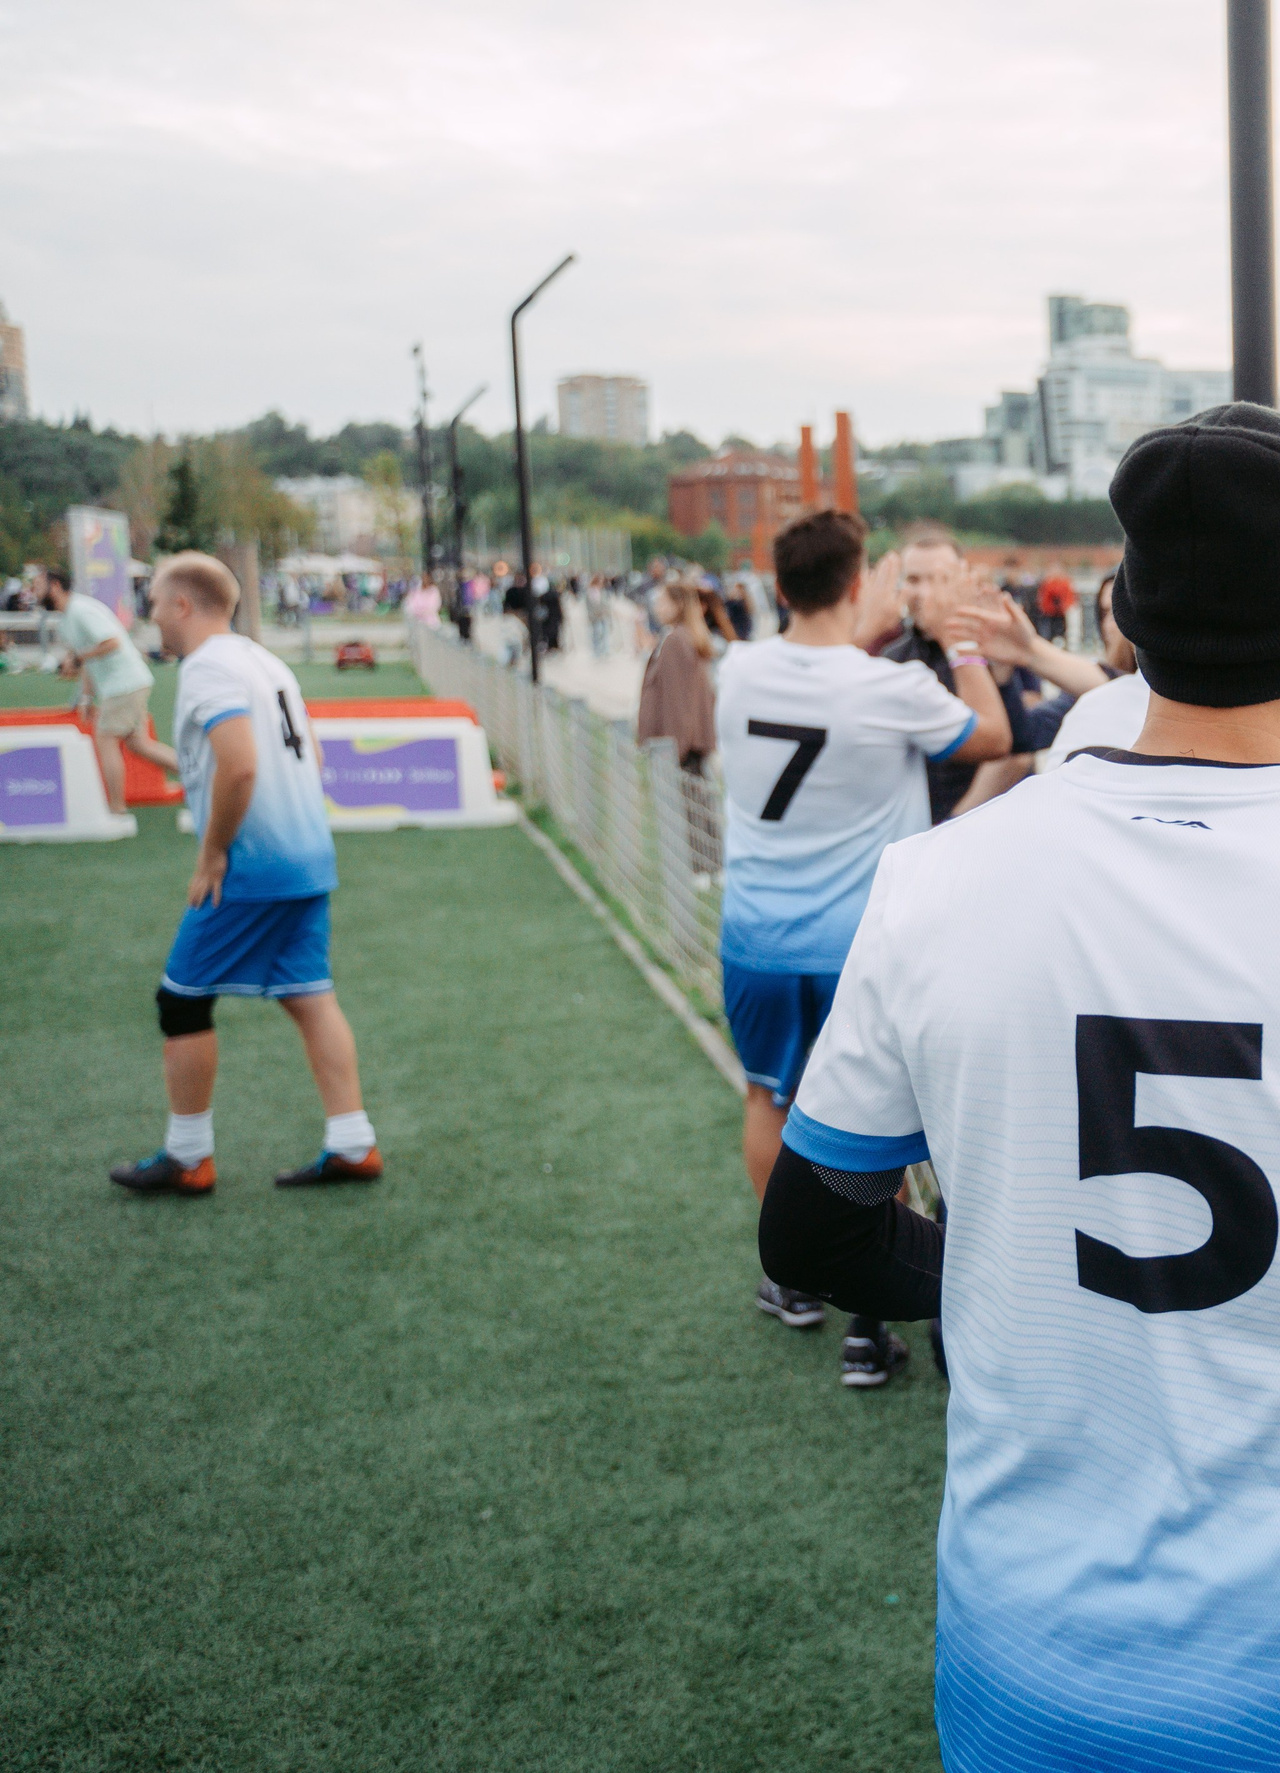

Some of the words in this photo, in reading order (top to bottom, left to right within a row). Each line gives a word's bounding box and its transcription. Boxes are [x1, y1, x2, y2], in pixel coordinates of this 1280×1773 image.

[277, 689, 303, 760] 4
[747, 719, 828, 822] 7
[1075, 1014, 1279, 1314] 5
